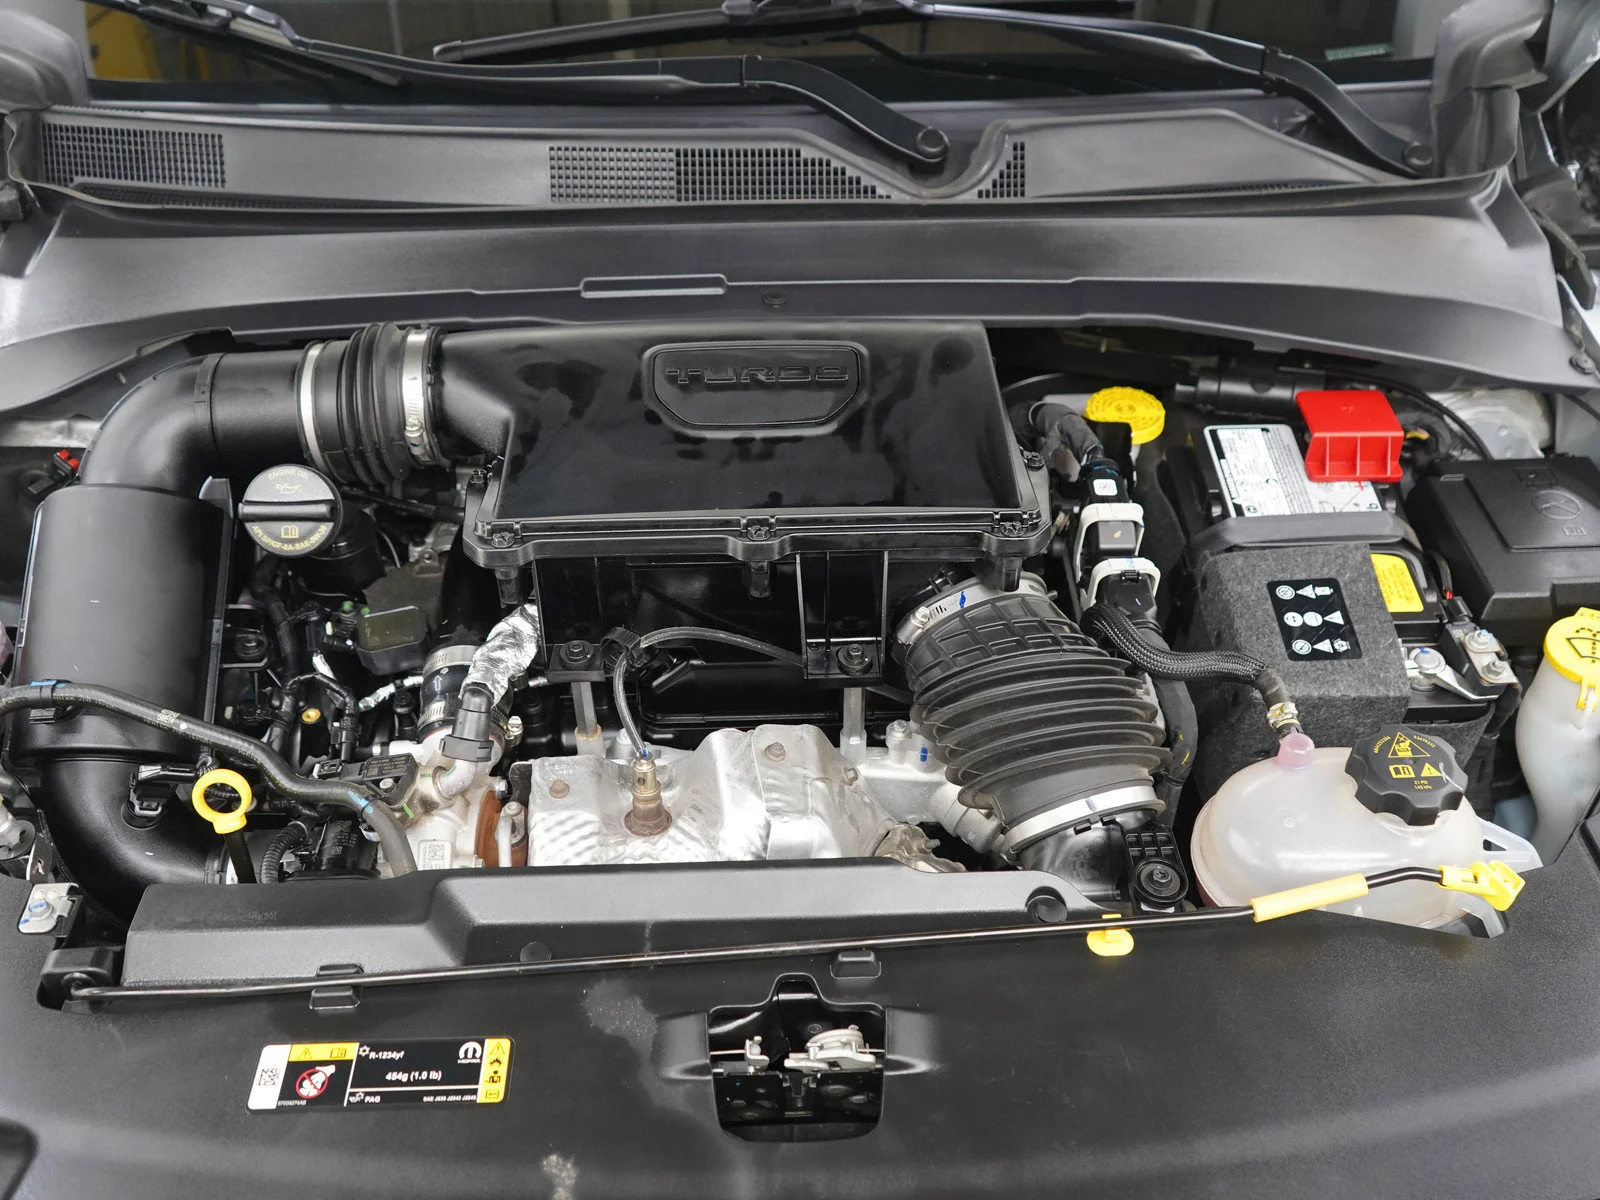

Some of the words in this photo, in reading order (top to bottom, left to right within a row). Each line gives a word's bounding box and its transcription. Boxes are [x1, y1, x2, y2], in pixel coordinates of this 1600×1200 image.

[666, 366, 849, 384] TURBO
[267, 469, 297, 480] ENGINE
[297, 469, 309, 480] OIL
[368, 1051, 405, 1061] R-1234yf
[385, 1072, 409, 1083] 454g
[410, 1071, 428, 1082] (1.0
[364, 1095, 381, 1103] PAG
